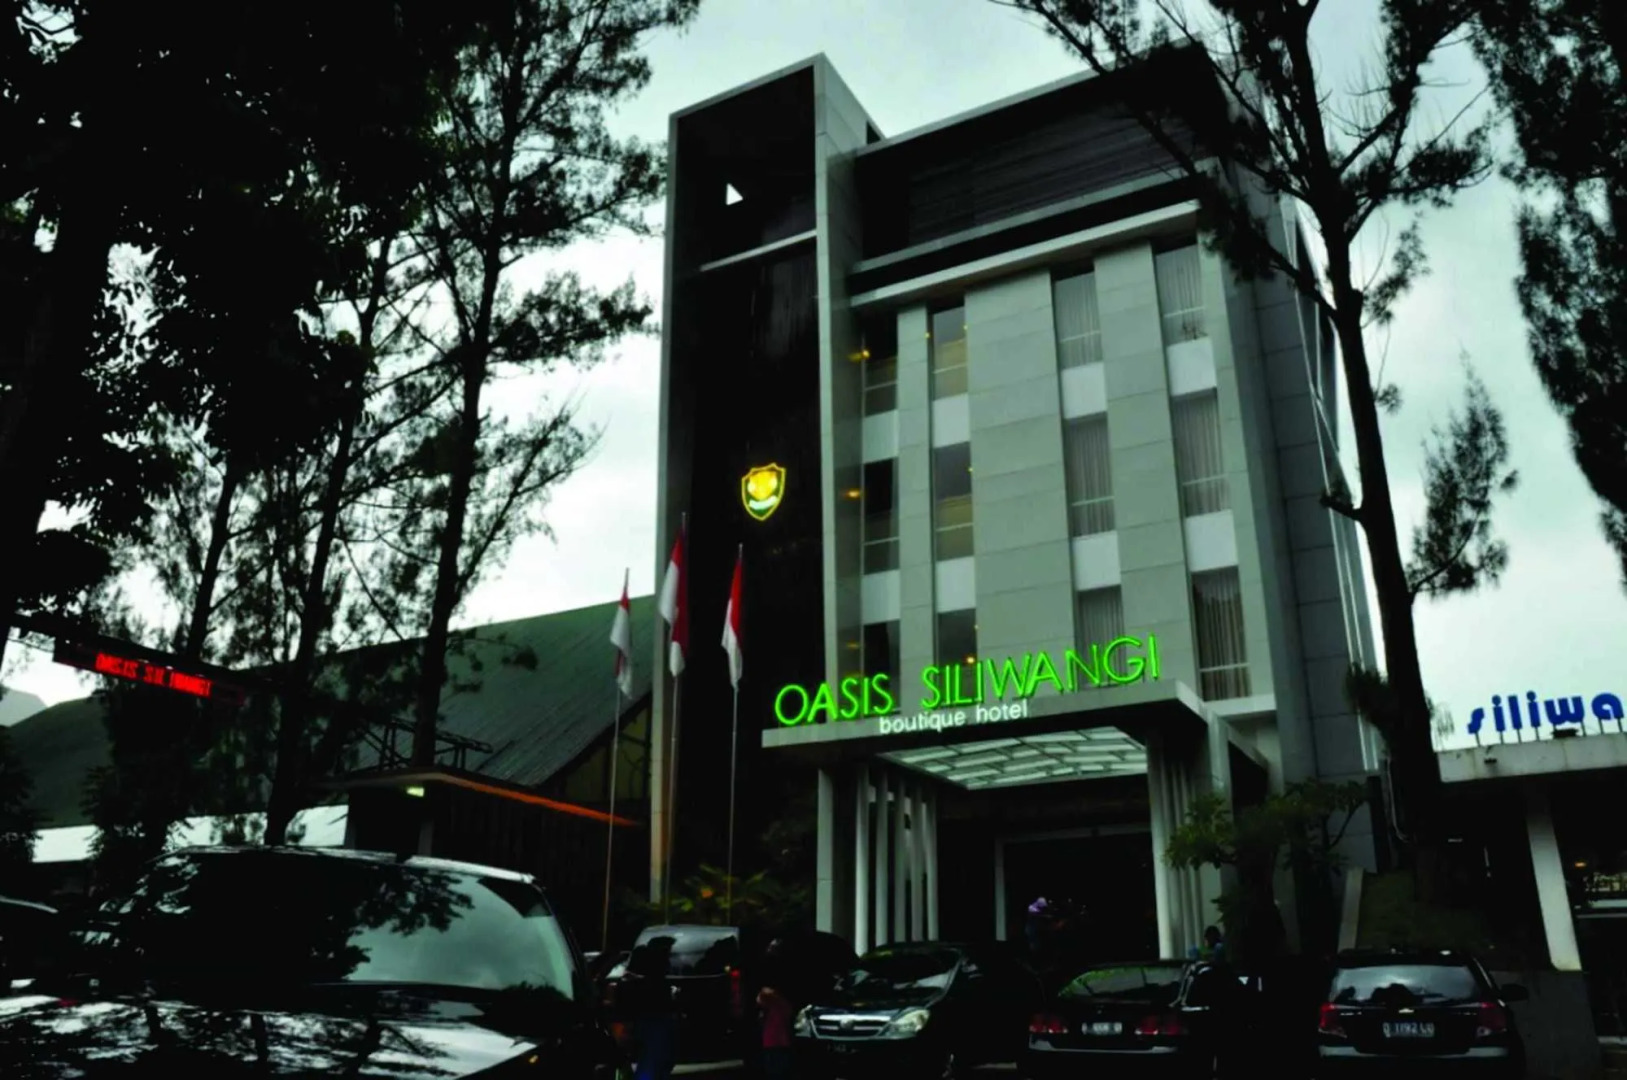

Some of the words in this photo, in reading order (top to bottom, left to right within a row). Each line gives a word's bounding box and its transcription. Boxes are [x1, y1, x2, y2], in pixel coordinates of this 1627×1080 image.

[774, 673, 895, 729] OASIS
[919, 632, 1162, 711] SILIWANGI
[879, 710, 967, 735] boutique
[976, 698, 1029, 723] hotel
[1467, 690, 1625, 734] siliwa
